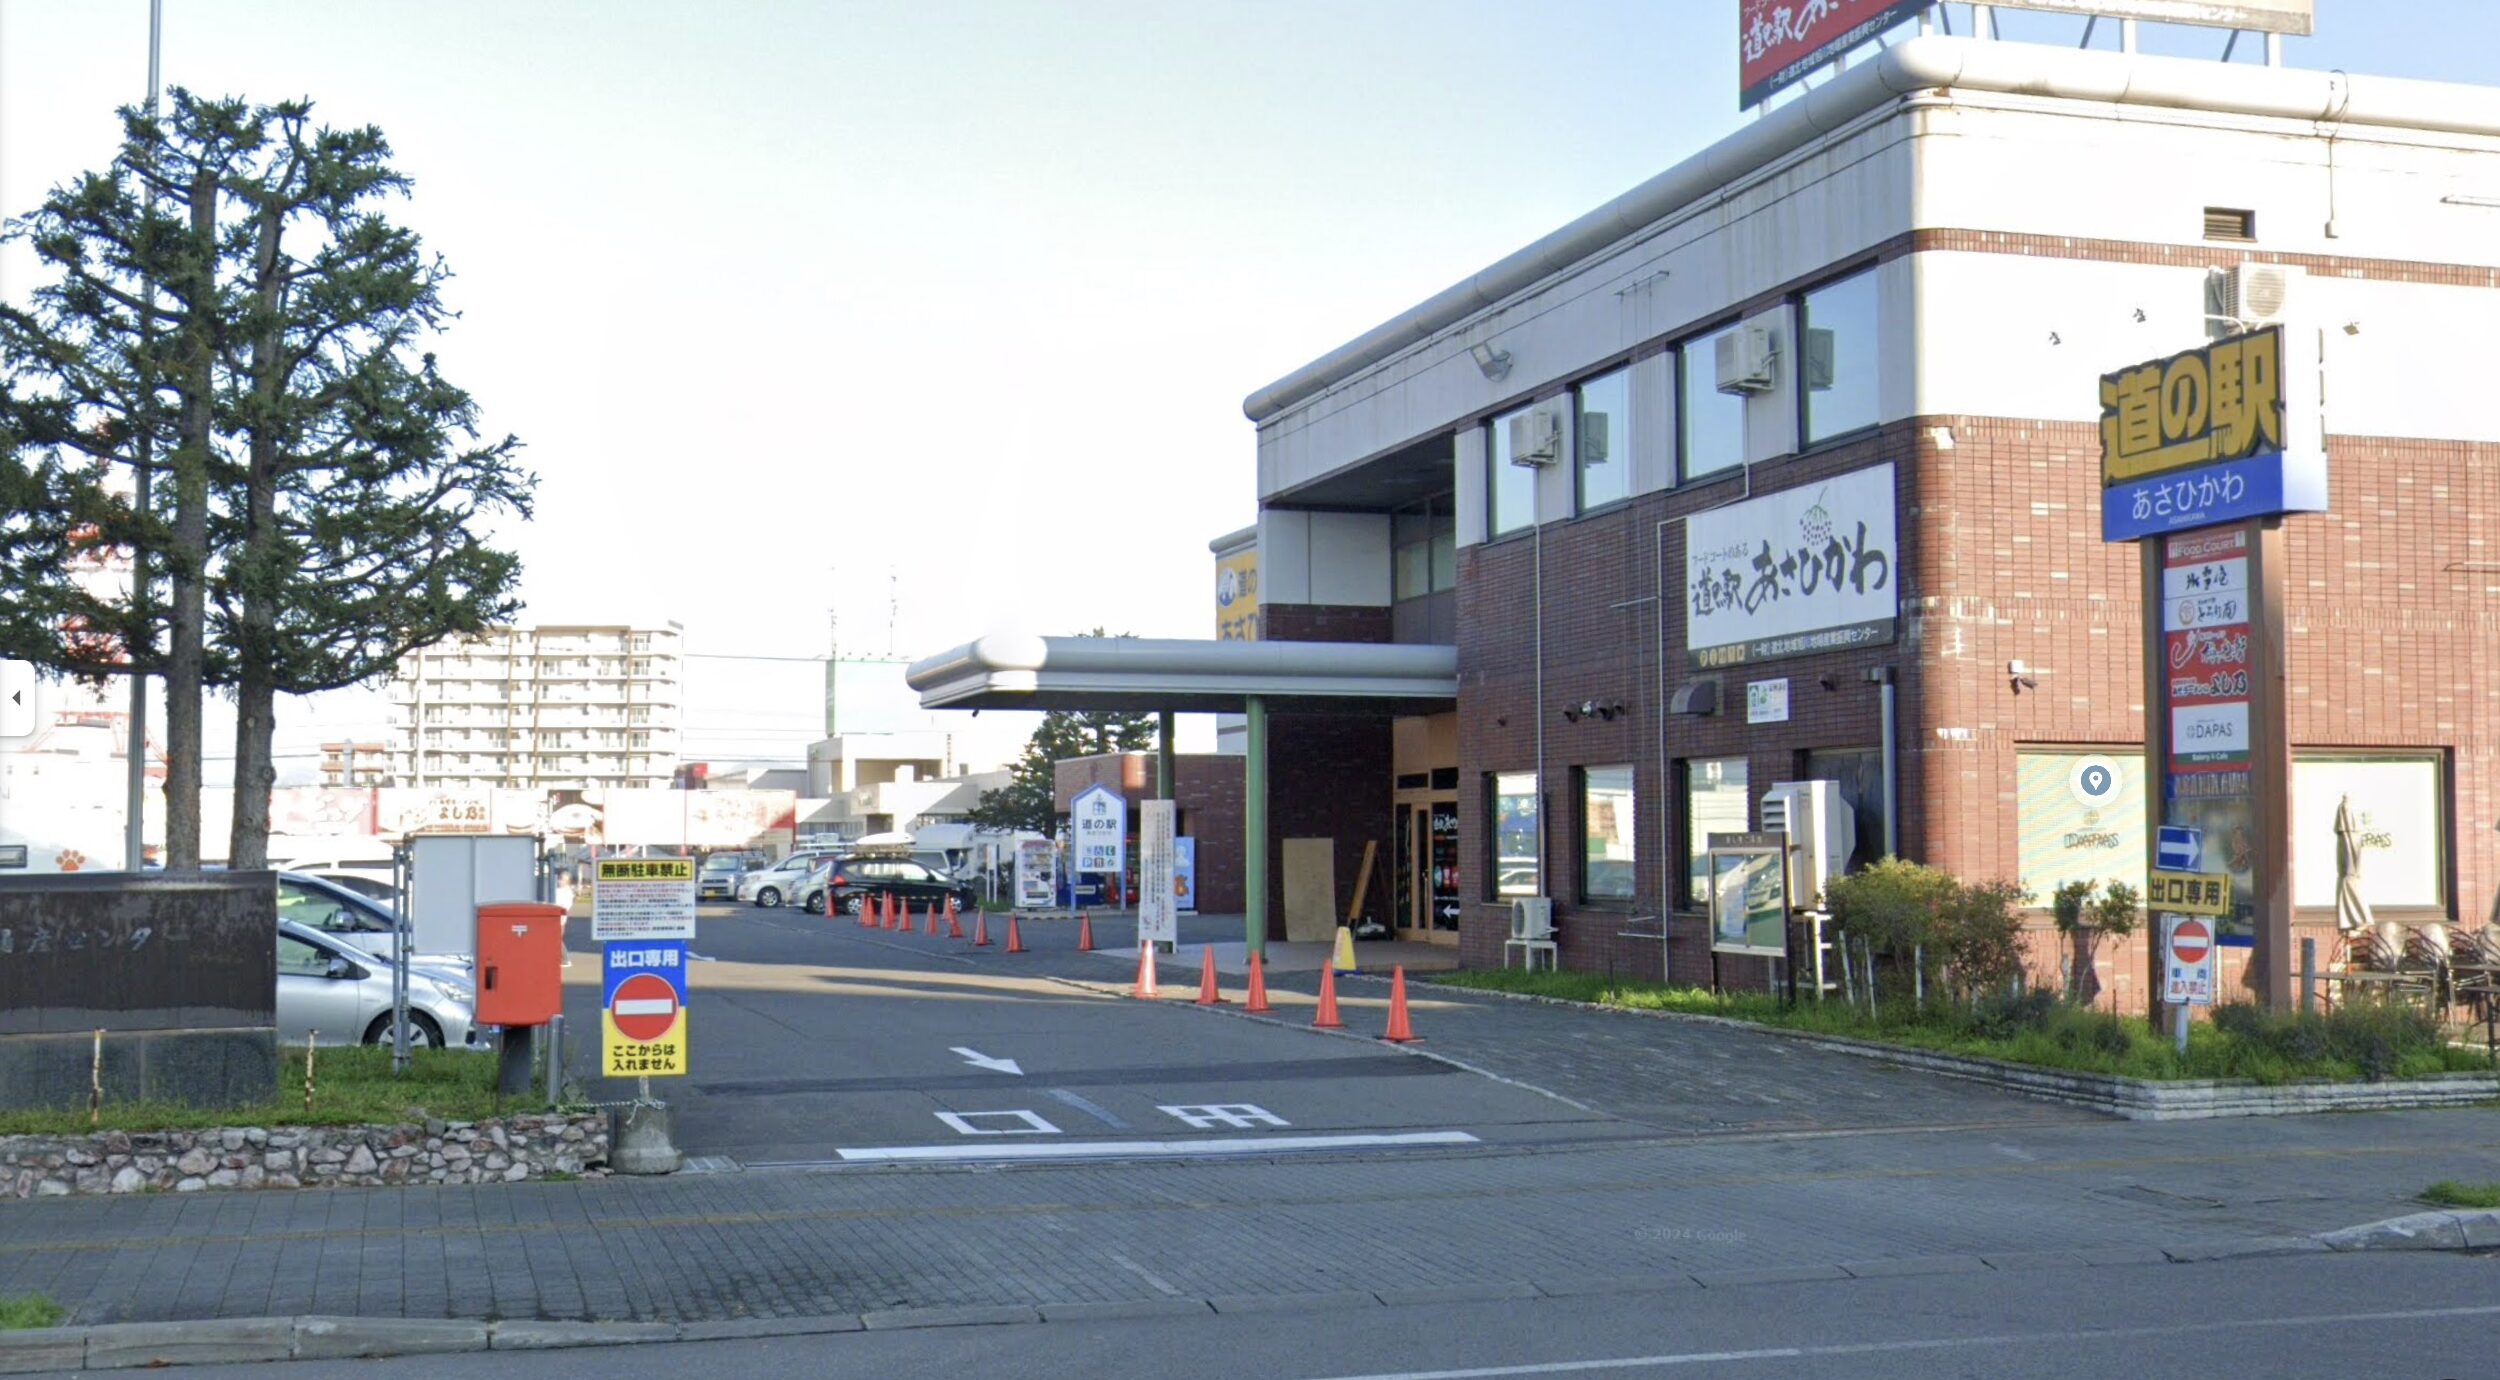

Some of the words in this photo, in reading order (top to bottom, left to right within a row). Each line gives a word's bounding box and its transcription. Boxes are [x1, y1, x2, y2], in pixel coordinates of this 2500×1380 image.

[2101, 328, 2281, 483] 道の駅
[2132, 470, 2245, 520] あさひかわ
[2196, 722, 2233, 738] DAPAS
[1082, 818, 1117, 831] 道の駅
[601, 862, 689, 878] 無断駐車禁止
[2152, 877, 2219, 906] 出口専用
[610, 949, 679, 968] 出口専用
[612, 1044, 676, 1058] ここからは
[612, 1058, 676, 1072] 入れません
